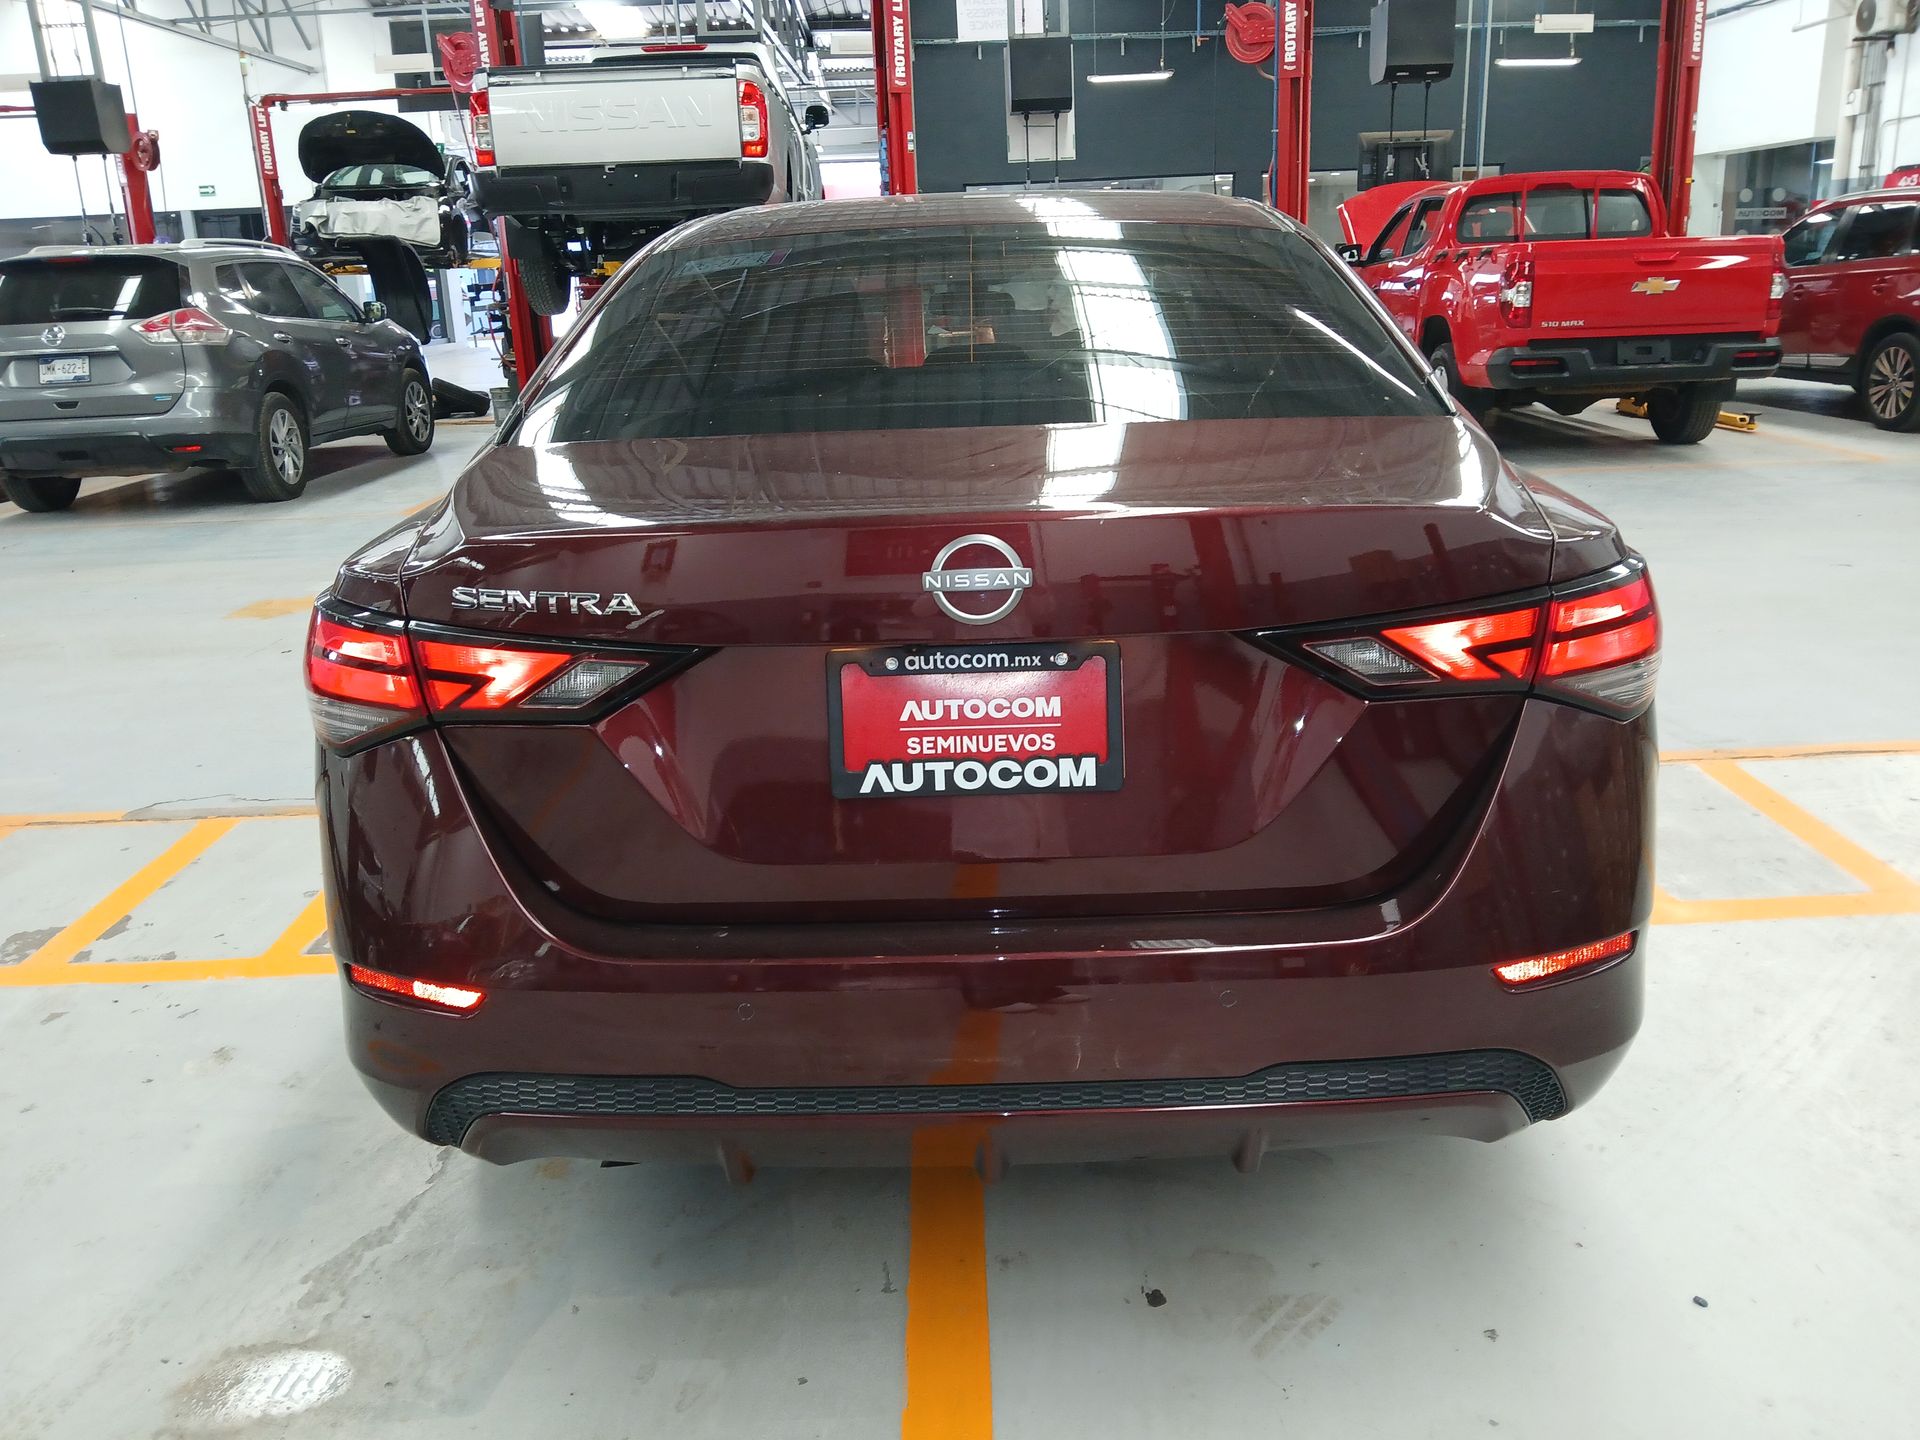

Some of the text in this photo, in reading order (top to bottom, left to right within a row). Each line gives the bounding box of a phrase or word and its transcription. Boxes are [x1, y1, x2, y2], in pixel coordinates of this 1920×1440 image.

[1284, 1, 1297, 63] ROTARY
[1692, 0, 1705, 53] ROTAR
[893, 15, 906, 78] ROTARY
[520, 94, 713, 134] NISSAN
[259, 130, 273, 170] ROTARY
[925, 571, 1030, 588] NISSAN
[451, 586, 642, 616] SENTRA
[904, 651, 1042, 671] autocom.mx
[899, 696, 1062, 721] AUTOCOM
[906, 733, 1056, 755] SEMINUEVOS
[859, 757, 1097, 793] AUTOCOM
